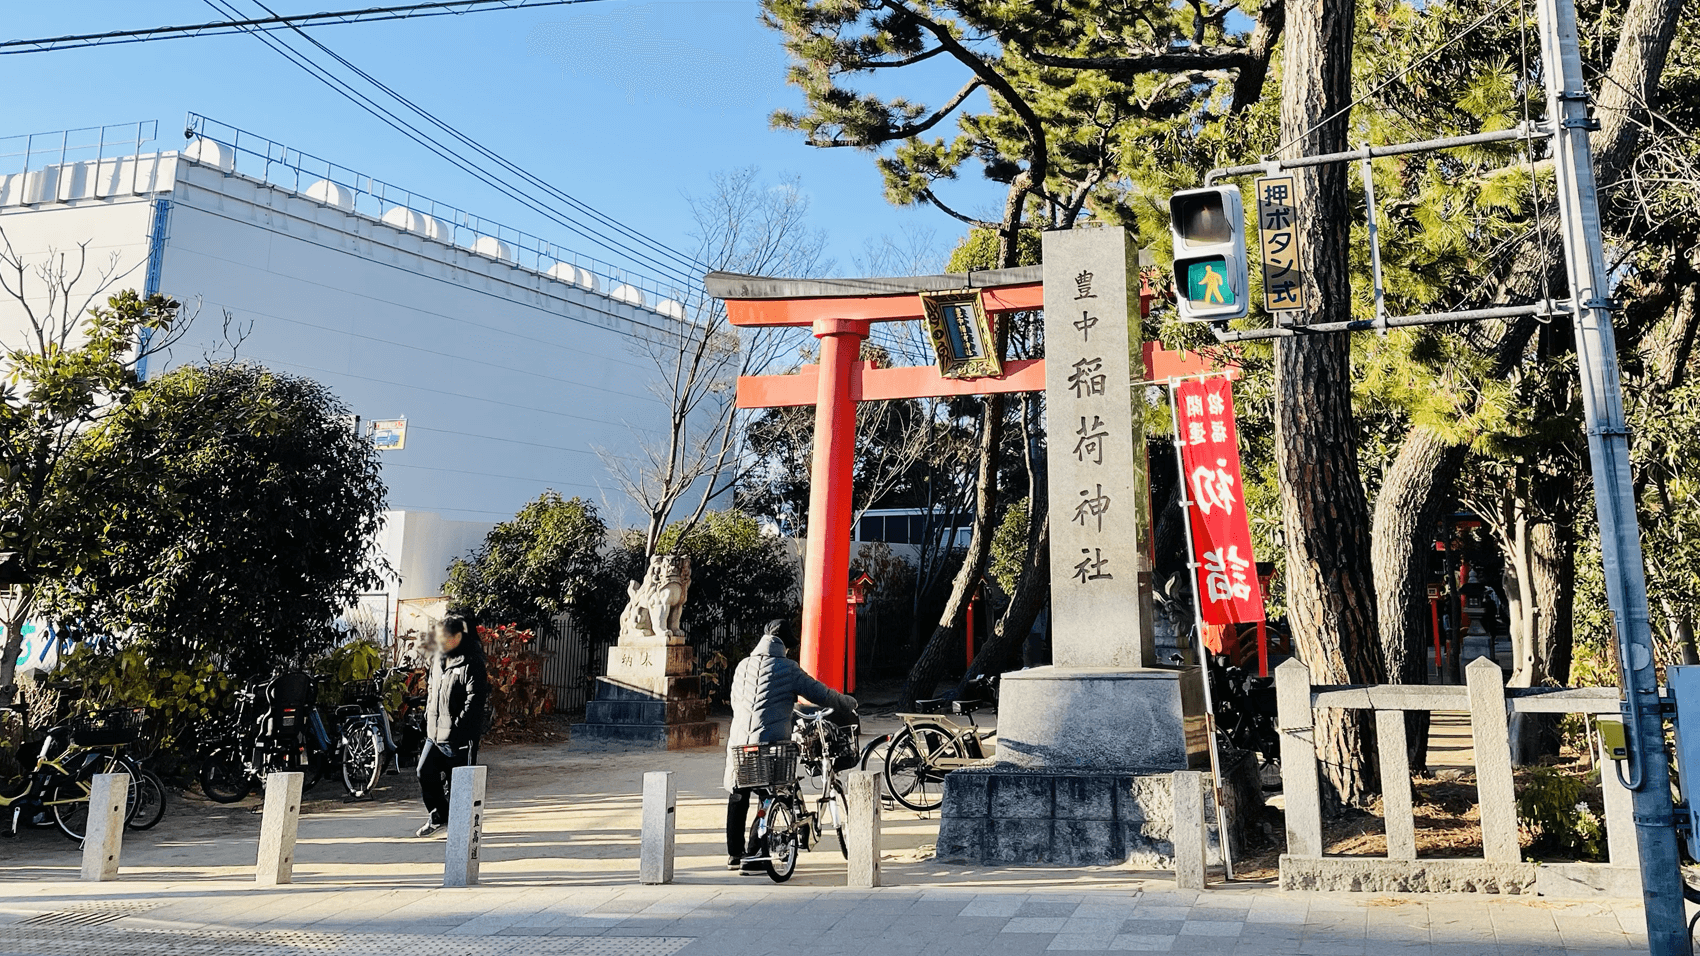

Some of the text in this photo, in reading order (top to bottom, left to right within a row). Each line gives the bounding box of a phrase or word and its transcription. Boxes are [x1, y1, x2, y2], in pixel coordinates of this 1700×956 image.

[1264, 184, 1297, 303] 押ボタン式
[1067, 269, 1114, 584] 豊中稲荷神社
